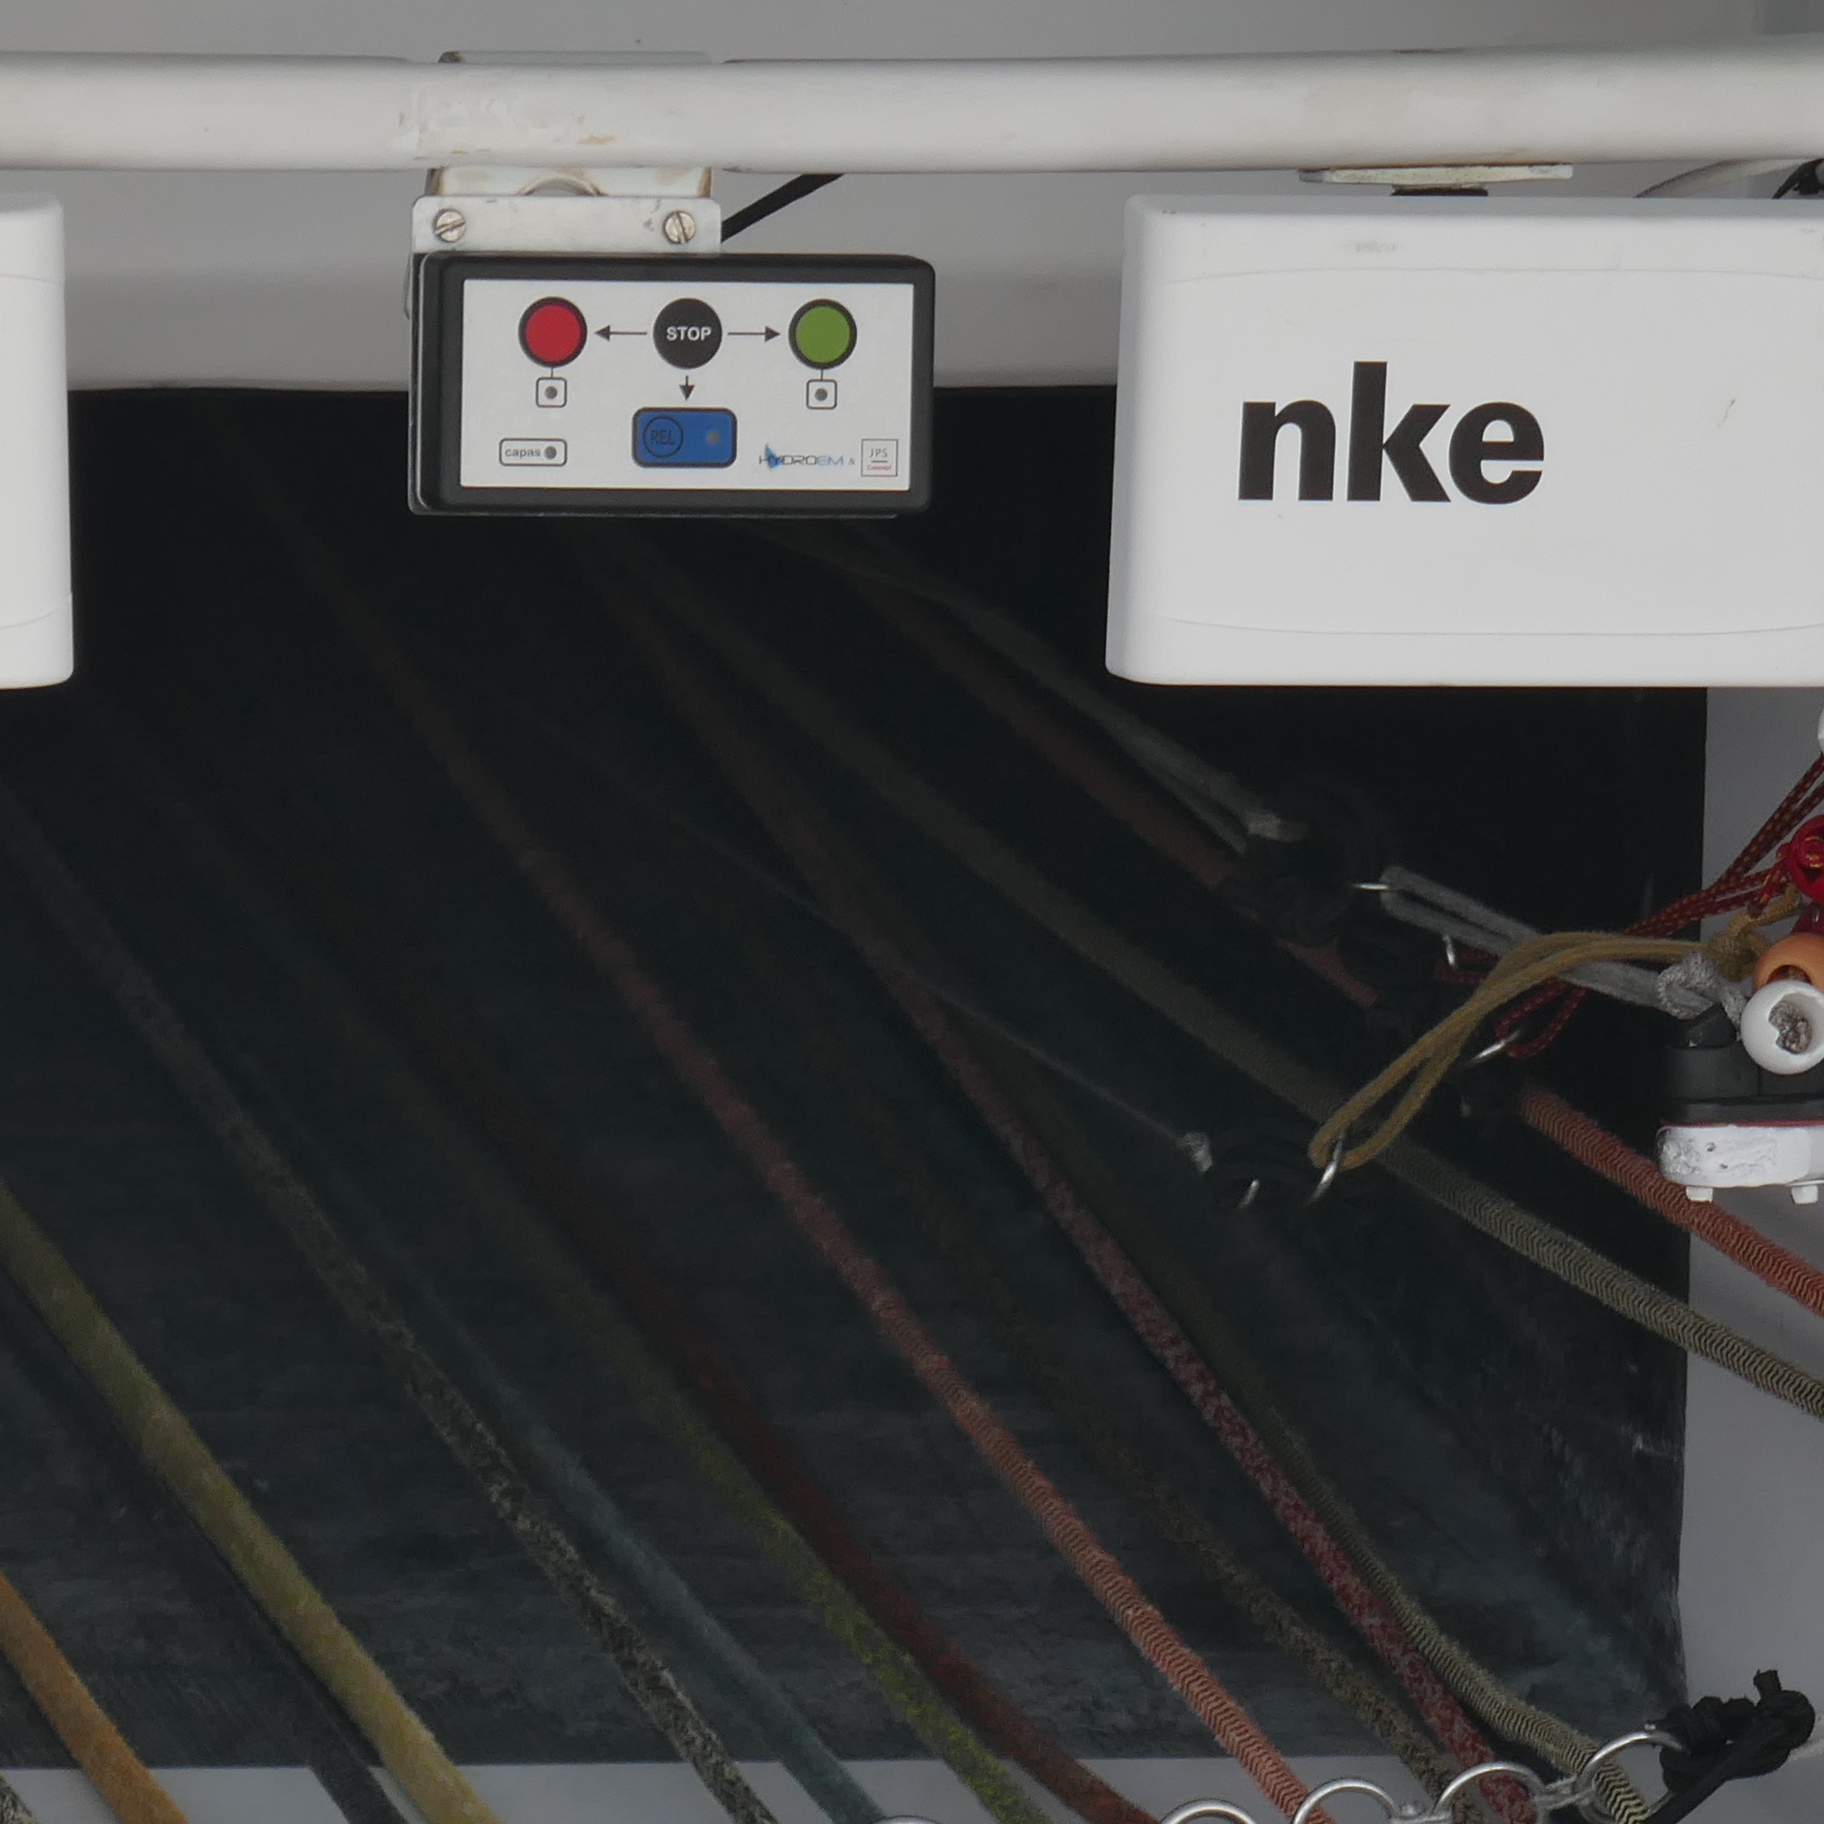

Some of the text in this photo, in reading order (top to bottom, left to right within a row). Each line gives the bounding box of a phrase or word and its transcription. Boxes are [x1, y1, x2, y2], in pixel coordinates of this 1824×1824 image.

[666, 326, 712, 341] STOP
[650, 430, 674, 446] REL
[1238, 360, 1545, 504] nke
[505, 447, 541, 458] capas
